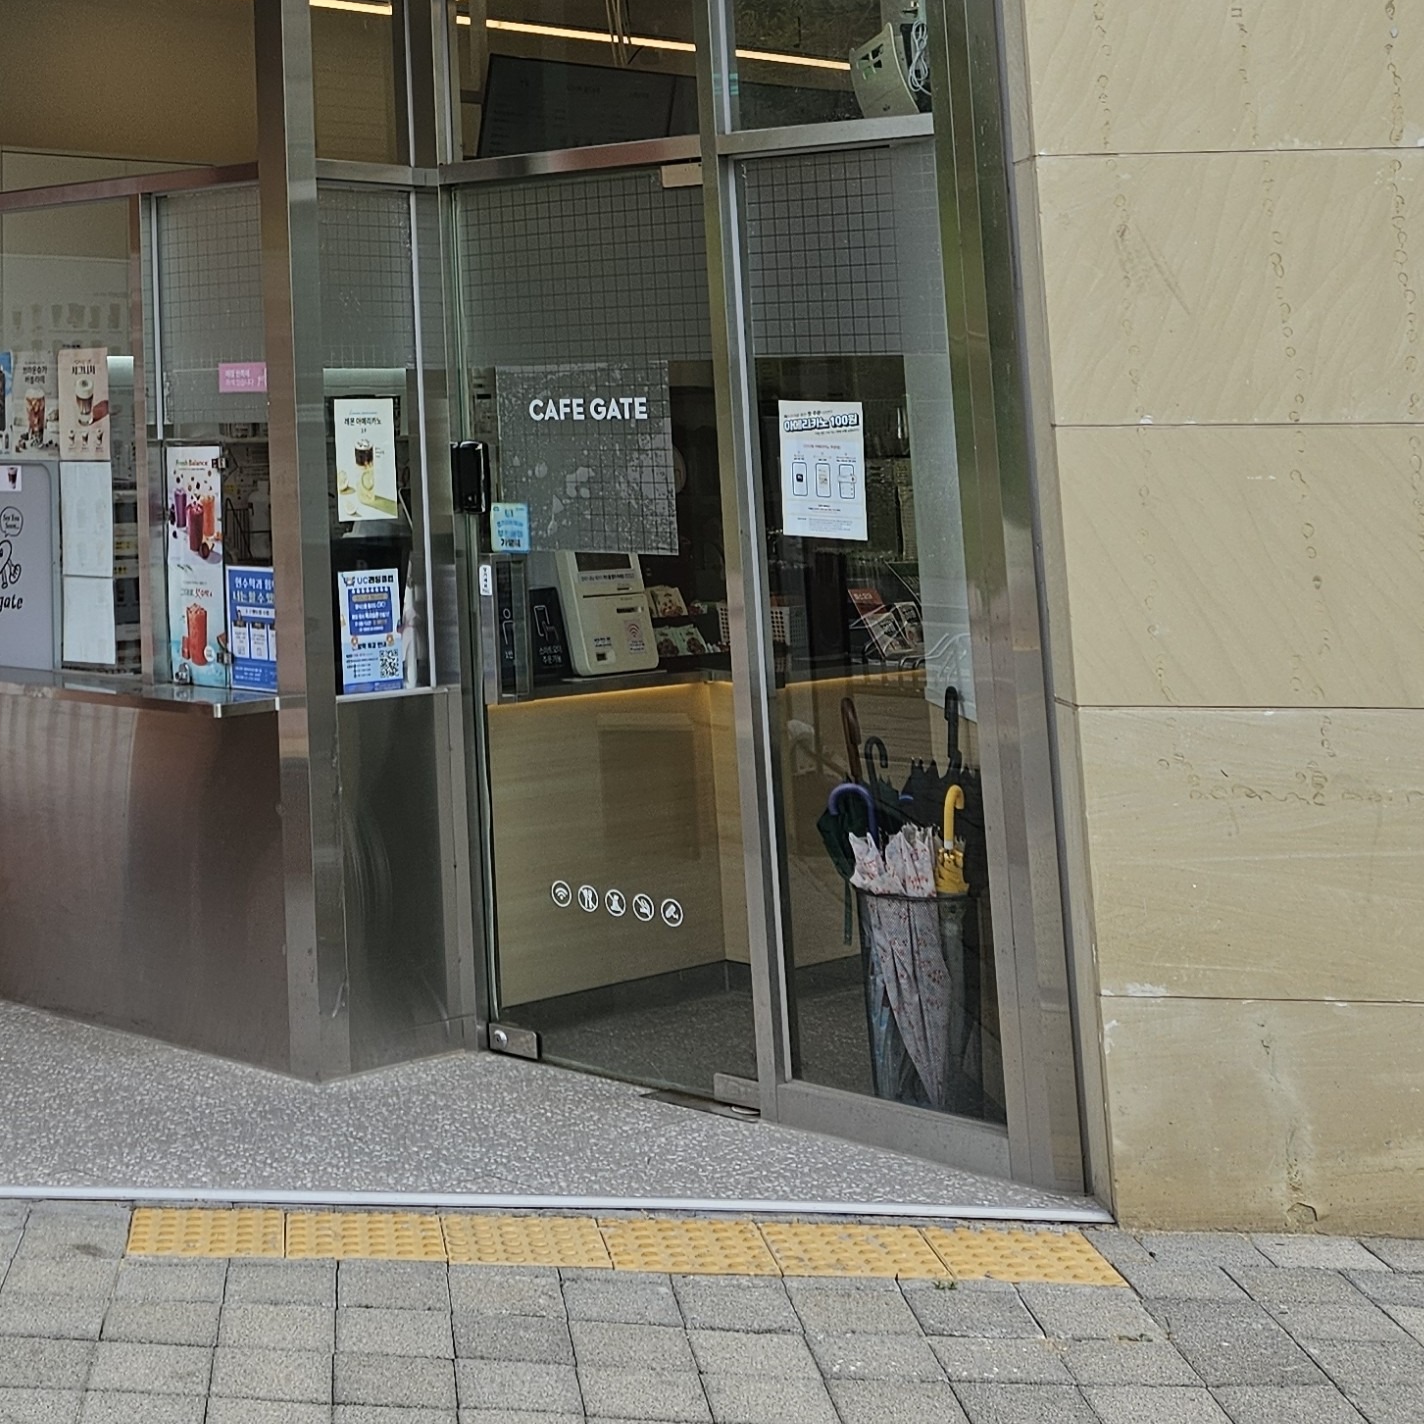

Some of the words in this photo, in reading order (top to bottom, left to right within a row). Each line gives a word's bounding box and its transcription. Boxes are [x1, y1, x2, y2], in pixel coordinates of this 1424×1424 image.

[529, 397, 585, 421] CAFE
[589, 396, 648, 421] GATE
[356, 417, 382, 426] 아메리카노
[783, 417, 830, 433] 아메리카노
[830, 413, 860, 428] 100원
